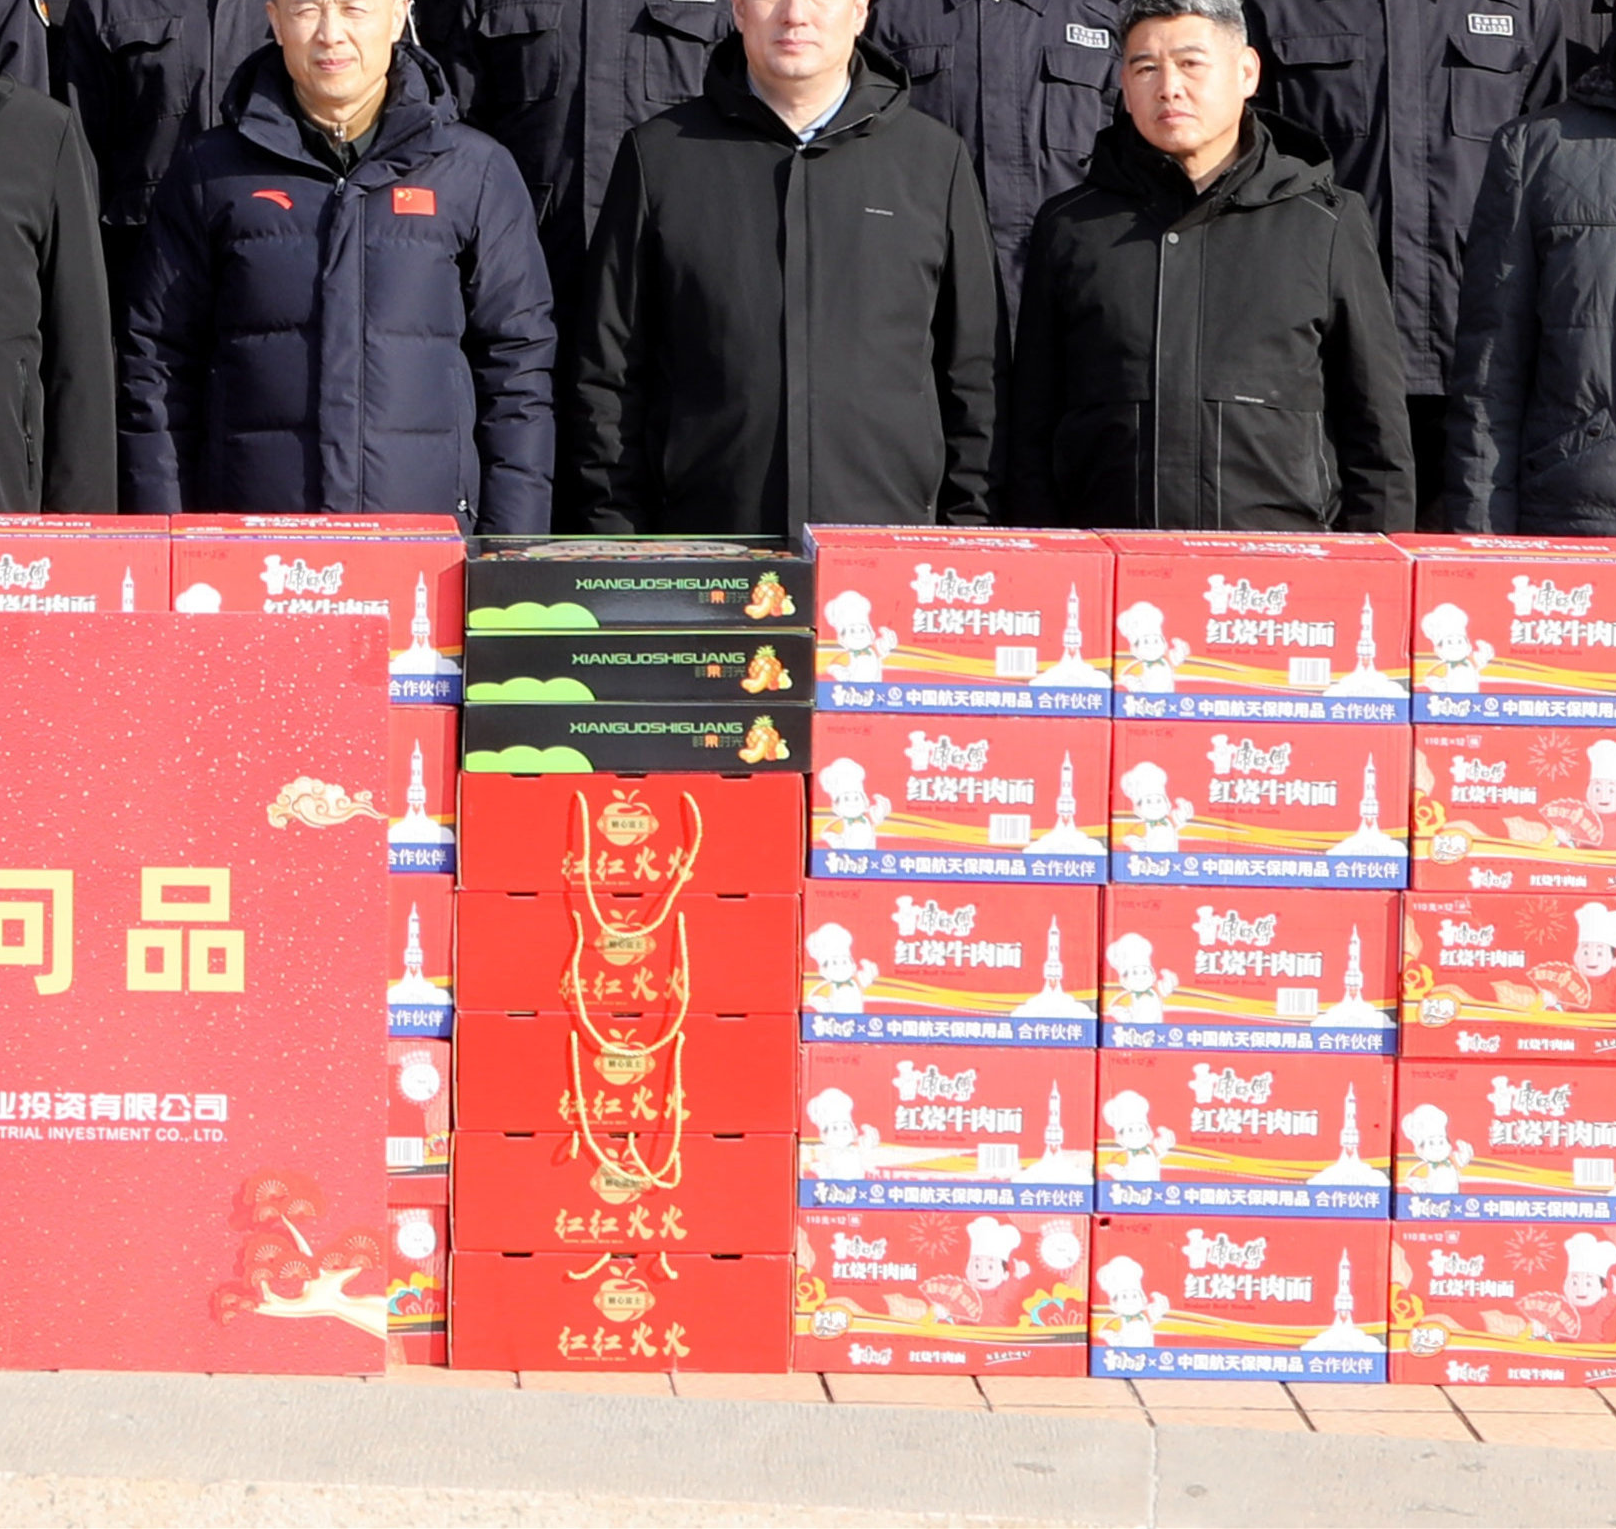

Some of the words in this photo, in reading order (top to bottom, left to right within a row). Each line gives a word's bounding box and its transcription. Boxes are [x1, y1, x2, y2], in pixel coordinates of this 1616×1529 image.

[576, 576, 749, 592] XIANGUOSHIGUANG
[911, 608, 1041, 637] 红烧牛肉面
[1205, 618, 1335, 647] 红烧牛肉面
[572, 651, 745, 667] XIANGUOSHIGUANG
[906, 690, 1033, 709] 中国航天保障用品
[1198, 700, 1325, 719] 中国航天保障用品
[570, 720, 743, 736] XIANGUOSHIGUANG
[905, 776, 1035, 805] 红烧牛肉面
[1207, 778, 1337, 807] 红烧牛肉面
[899, 857, 1026, 876] 中国航天保障用品
[1202, 860, 1329, 879] 中国航天保障用品
[892, 940, 1022, 969] 红烧牛肉面
[1193, 949, 1323, 978] 红烧牛肉面
[886, 1021, 1013, 1040] 中国航天保障用品
[1186, 1030, 1313, 1049] 中国航天保障用品
[893, 1105, 1023, 1134] 红烧牛肉面
[1189, 1107, 1319, 1136] 红烧牛肉面
[48, 1127, 153, 1142] INVESTMENT
[888, 1187, 1015, 1206] 中国航天保障用品
[1183, 1189, 1310, 1208] 中国航天保障用品
[1483, 1200, 1610, 1219] 中国航天保障用品
[555, 1204, 687, 1240] 红红火火
[1182, 1273, 1312, 1302] 红烧牛肉面
[558, 1322, 690, 1358] 红红火火
[1177, 1355, 1304, 1374] 中国航天保障用品
